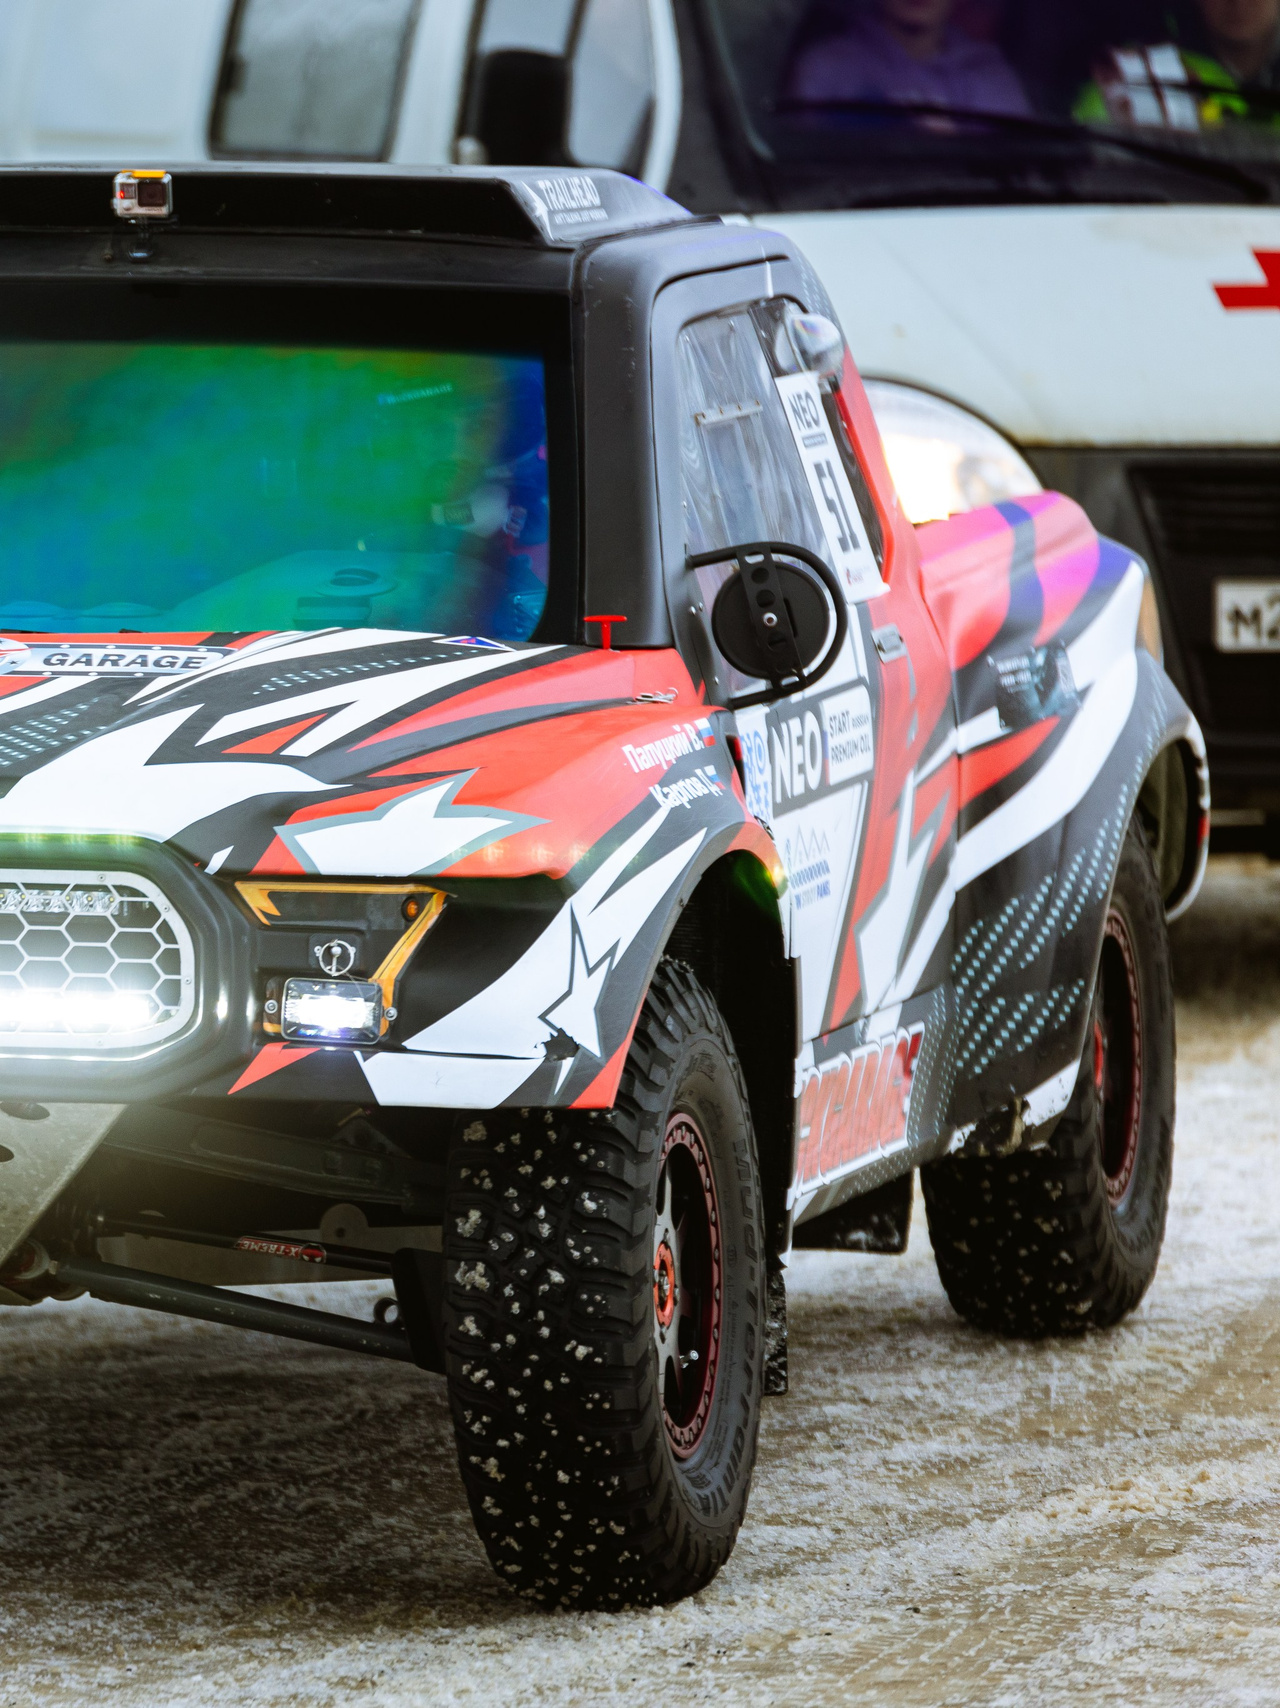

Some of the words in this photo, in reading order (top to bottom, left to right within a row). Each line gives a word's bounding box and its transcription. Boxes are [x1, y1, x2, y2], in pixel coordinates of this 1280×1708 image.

[537, 175, 602, 211] TRAILHEAD
[787, 391, 821, 431] NEO
[813, 460, 861, 553] 51
[42, 653, 209, 671] GARAGE
[829, 710, 851, 739] START
[621, 724, 694, 774] Папуцкий
[770, 710, 823, 805] NEO
[648, 774, 712, 810] Карпов
[242, 1241, 297, 1257] X-TREME
